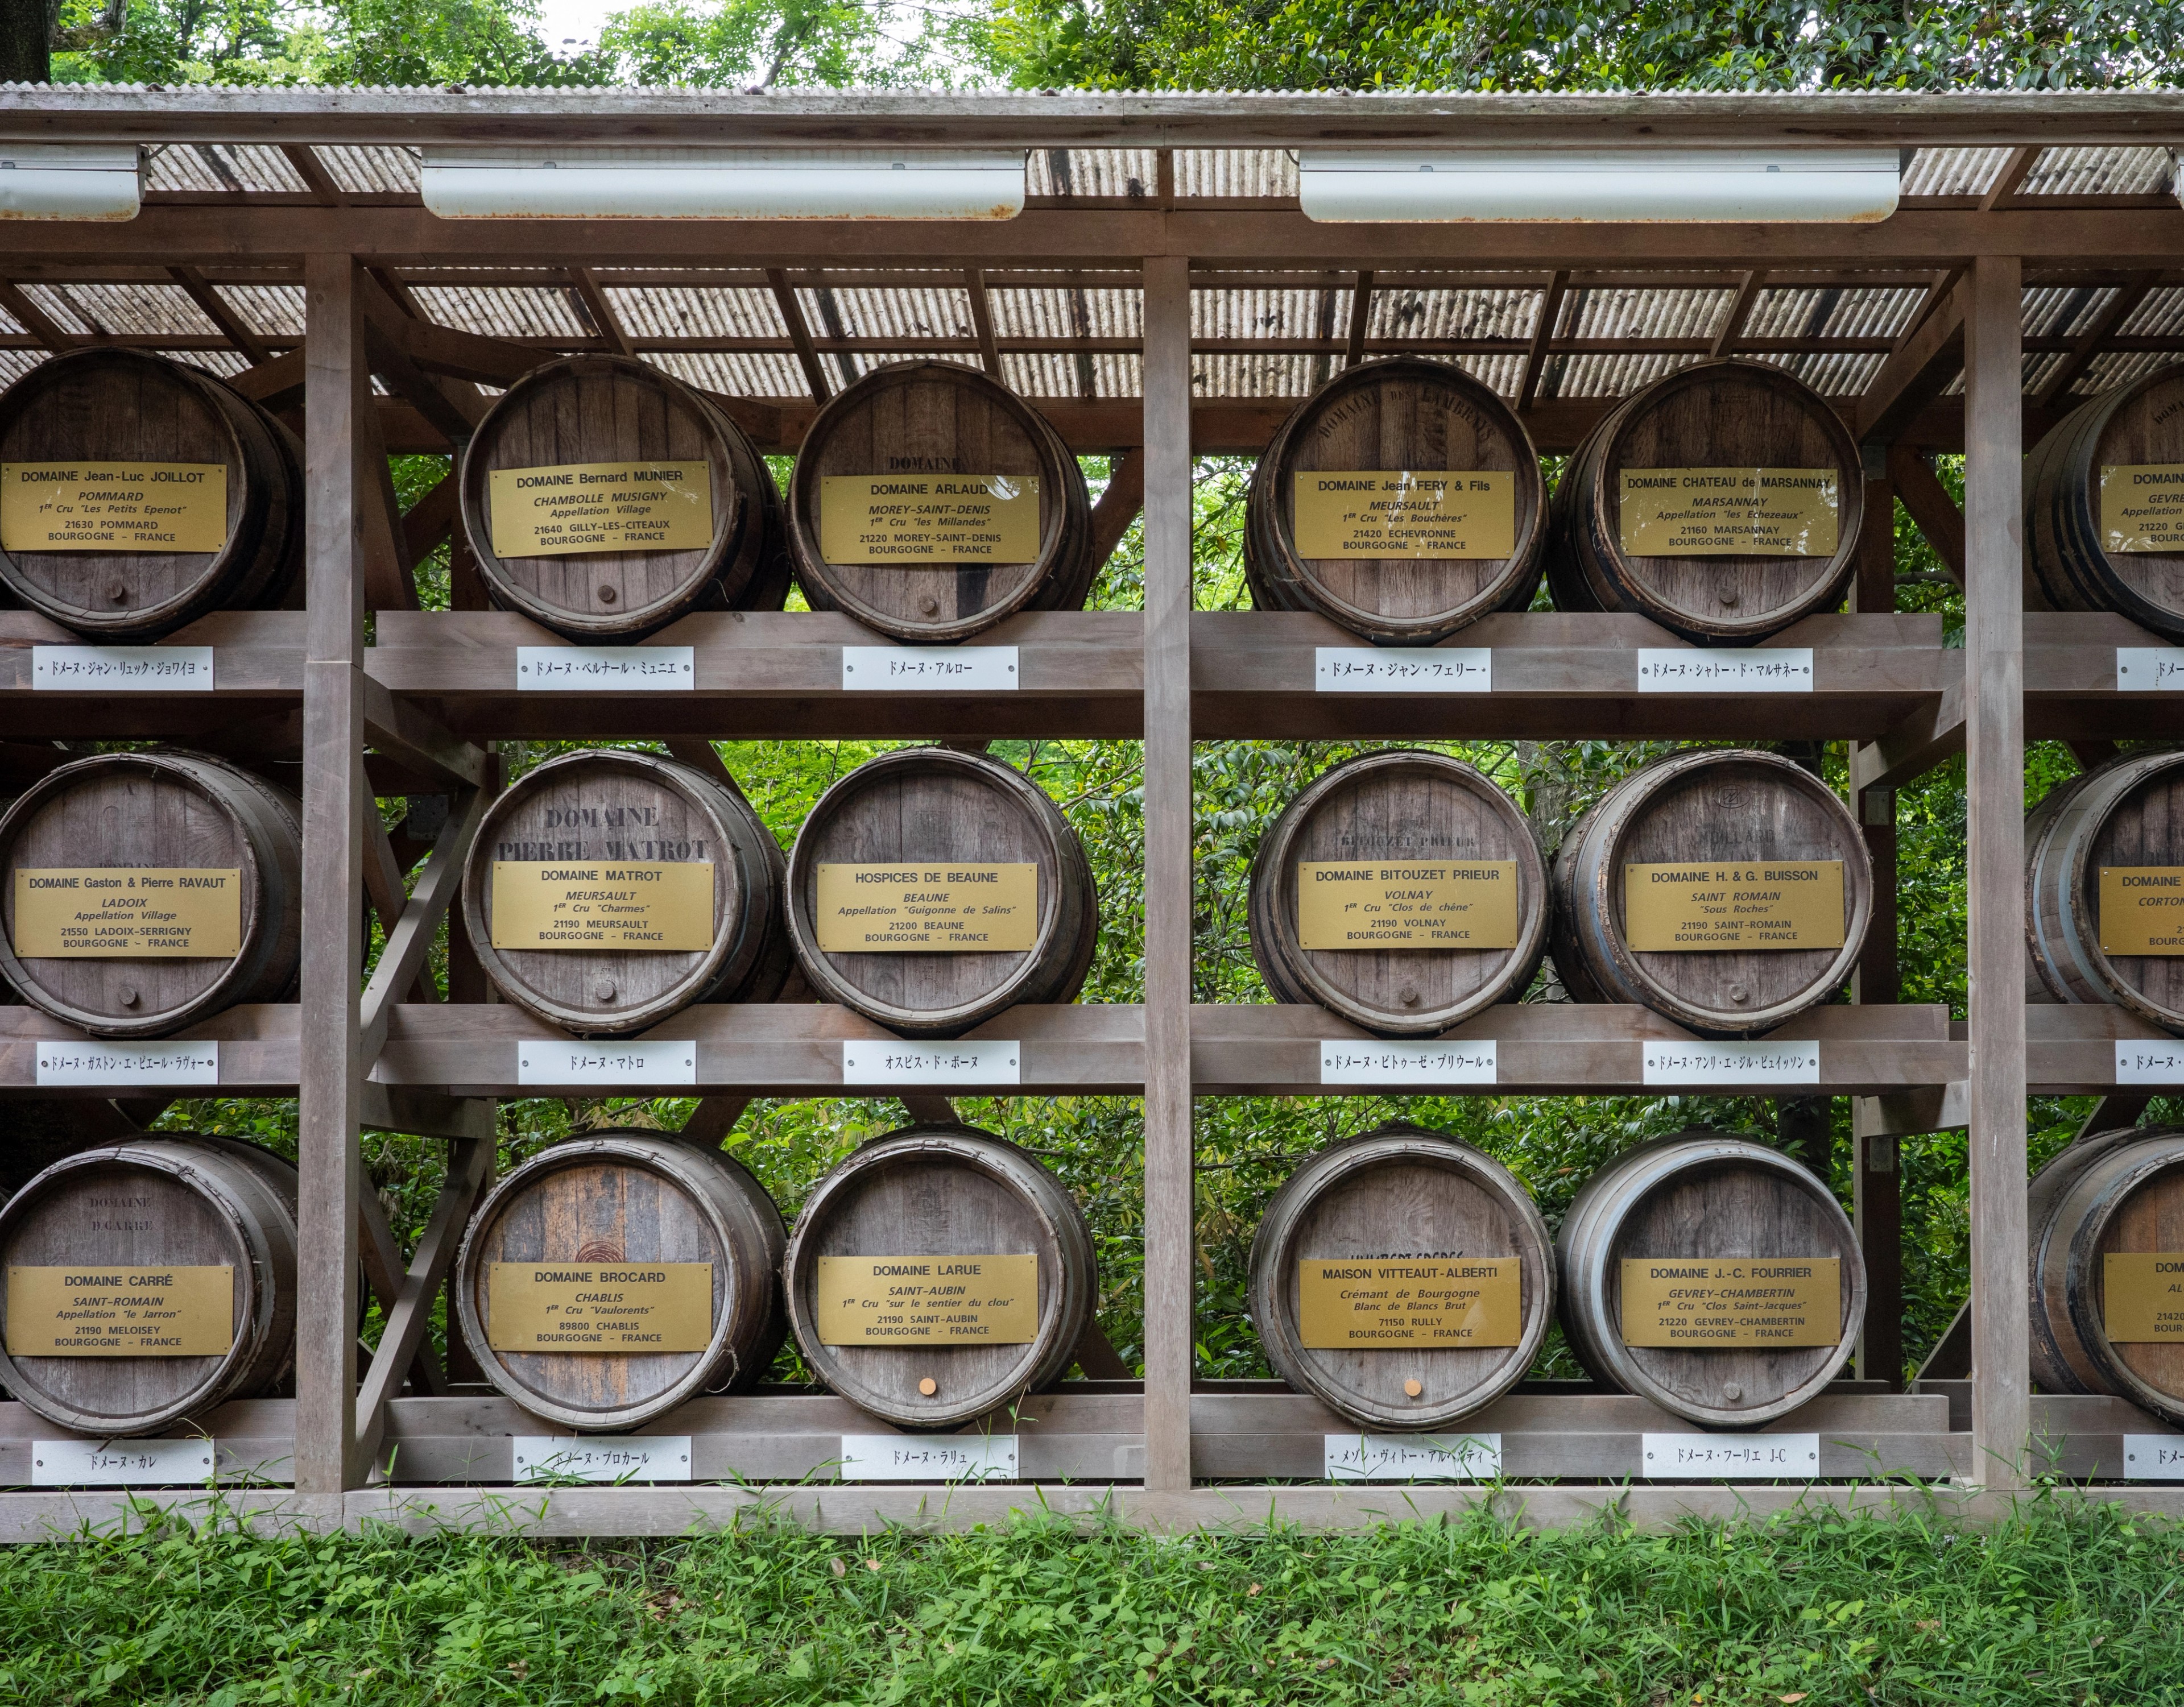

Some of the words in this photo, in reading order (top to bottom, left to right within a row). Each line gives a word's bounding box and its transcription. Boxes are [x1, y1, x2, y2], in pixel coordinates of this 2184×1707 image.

[21, 470, 78, 482] DOMAINE
[150, 471, 205, 483] JOILLOT
[516, 474, 574, 488] DOMAINE
[578, 471, 627, 484] Bernard
[633, 470, 683, 482] MUNIER
[1627, 477, 1677, 488] DOMAINE
[1682, 476, 1736, 488] CHATEAU
[1742, 477, 1755, 487] de
[1760, 477, 1830, 488] MARSANNAY
[870, 483, 928, 495] DOMAINE
[934, 483, 988, 495] ARLAUD
[1318, 480, 1376, 491] DOMAINE
[1381, 480, 1410, 491] Jean
[1416, 480, 1448, 491] FERY
[1454, 480, 1463, 491] &
[1469, 480, 1490, 491] Fils
[77, 491, 144, 501] POMMARD
[533, 493, 604, 507] CHAMBOLLE
[610, 491, 668, 502] MUSIGNY
[1368, 500, 1440, 511] MEURSAULT
[1691, 497, 1768, 507] MARSANNAY
[549, 506, 609, 519] Appellation
[616, 504, 651, 515] Village
[2120, 506, 2184, 518] Appellation
[64, 520, 93, 529] 21630
[100, 520, 158, 529] POMMARD
[889, 517, 907, 527] Cru
[2138, 522, 2168, 531] 21220
[533, 524, 562, 535] 21640
[1352, 529, 1382, 538] 21420
[1388, 529, 1456, 538] ECHEVRONNE
[1680, 525, 1707, 535] 21160
[1714, 525, 1780, 535] MARSANNAY
[48, 532, 114, 540] BOURGOGNE
[134, 532, 175, 541] FRANCE
[859, 533, 887, 542] 21220
[1343, 541, 1408, 549] BOURGOGNE
[1426, 541, 1466, 549] FRANCE
[52, 661, 195, 676] ドメーヌ・ジャン・リュック・ジョワイヨ
[537, 661, 677, 676] ドメーヌ・ベルナール・ミュニエ
[890, 661, 973, 676] ドメーヌ・アルロー
[1333, 661, 1477, 677] ドメーヌ・ジャン・フェリー
[1653, 662, 1800, 678] ドメーヌ・シャトー・ド・マルサネー
[547, 807, 660, 828] DOMAINE
[498, 840, 589, 862] PIERRE
[605, 840, 708, 861] MATROT
[541, 869, 598, 881] DOMAINE
[605, 870, 663, 881] MATROT
[855, 872, 918, 883] HOSPICES
[924, 872, 941, 882] DE
[947, 872, 998, 882] BEAUNE
[1316, 869, 1374, 881] DOMAINE
[1380, 869, 1446, 880] BITOUZET
[1453, 869, 1499, 880] PRIEUR
[1651, 871, 1710, 882] DOMAINE
[1715, 871, 1728, 881] H.
[1732, 871, 1741, 881] &
[1745, 871, 1758, 881] G.
[1764, 870, 1818, 881] BUISSON
[29, 877, 79, 889] DOMAINE
[84, 877, 122, 888] Gaston
[127, 877, 135, 888] &
[141, 877, 173, 888] Pierre
[179, 877, 226, 888] RAVAUT
[2121, 876, 2184, 886] DOMAINE
[565, 890, 637, 901] MEURSAULT
[903, 893, 950, 902] BEAUNE
[1384, 890, 1433, 900] VOLNAY
[1690, 892, 1726, 902] SAINT
[1732, 891, 1781, 901] ROMAIN
[101, 898, 148, 908] LADOIX
[73, 910, 134, 922] Appellation
[141, 910, 177, 922] Village
[553, 919, 580, 928] 21190
[586, 919, 648, 929] MEURSAULT
[888, 921, 917, 930] 21200
[924, 921, 964, 930] BEAUNE
[1370, 919, 1397, 927] 21190
[1403, 918, 1446, 927] VOLNAY
[1681, 921, 1707, 930] 21190
[60, 927, 88, 936] 21550
[63, 938, 128, 948] BOURGOGNE
[147, 938, 189, 947] FRANCE
[864, 933, 930, 942] BOURGOGNE
[949, 933, 988, 941] FRANCE
[52, 1056, 205, 1071] ドメーヌ・ガストン・エ・ピエール・ラヴォー
[570, 1055, 644, 1071] ドメーヌ・マトロ
[885, 1055, 979, 1070] オスピス・ド・ボーヌ
[1335, 1054, 1484, 1070] ドメーヌ・ビトゥーゼ・プリウール
[1660, 1055, 1805, 1071] ドメーヌ・アンリ・エ・ジル・ビュイッソン
[872, 1265, 930, 1276] DOMAINE
[937, 1264, 981, 1275] LARUE
[1322, 1268, 1372, 1279] MAISON
[1650, 1267, 1709, 1279] DOMAINE
[1751, 1267, 1811, 1278] FOURRIER
[64, 1275, 123, 1286] DOMAINE
[128, 1273, 173, 1286] CARRÉ
[534, 1271, 593, 1282] DOMAINE
[599, 1271, 665, 1282] BROCARD
[575, 1292, 624, 1302] CHABLIS
[1339, 1288, 1388, 1299] Crémant
[1395, 1288, 1410, 1299] de
[1417, 1288, 1480, 1300] Bourgogne
[1353, 1302, 1381, 1311] Blanc
[1387, 1302, 1400, 1310] de
[1406, 1301, 1438, 1310] Blancs
[1444, 1301, 1466, 1310] Brut
[876, 1315, 903, 1324] 21190
[1378, 1317, 1404, 1327] 71150
[1411, 1317, 1442, 1326] RULLY
[1658, 1317, 1687, 1326] 21220
[75, 1326, 101, 1335] 21190
[108, 1325, 160, 1335] MELOISEY
[559, 1321, 589, 1331] 89800
[596, 1321, 639, 1331] CHABLIS
[865, 1327, 930, 1335] BOURGOGNE
[949, 1325, 989, 1335] FRANCE
[1670, 1329, 1736, 1337] BOURGOGNE
[1755, 1328, 1793, 1337] FRANCE
[54, 1337, 121, 1346] BOURGOGNE
[140, 1337, 181, 1346] FRANCE
[894, 1451, 967, 1466] ドメーヌ・ラリュ
[1677, 1448, 1761, 1463] ドメーヌ・フーリエ
[1770, 1448, 1786, 1463] J-C
[91, 1455, 158, 1470] ドメーヌ・カレ
